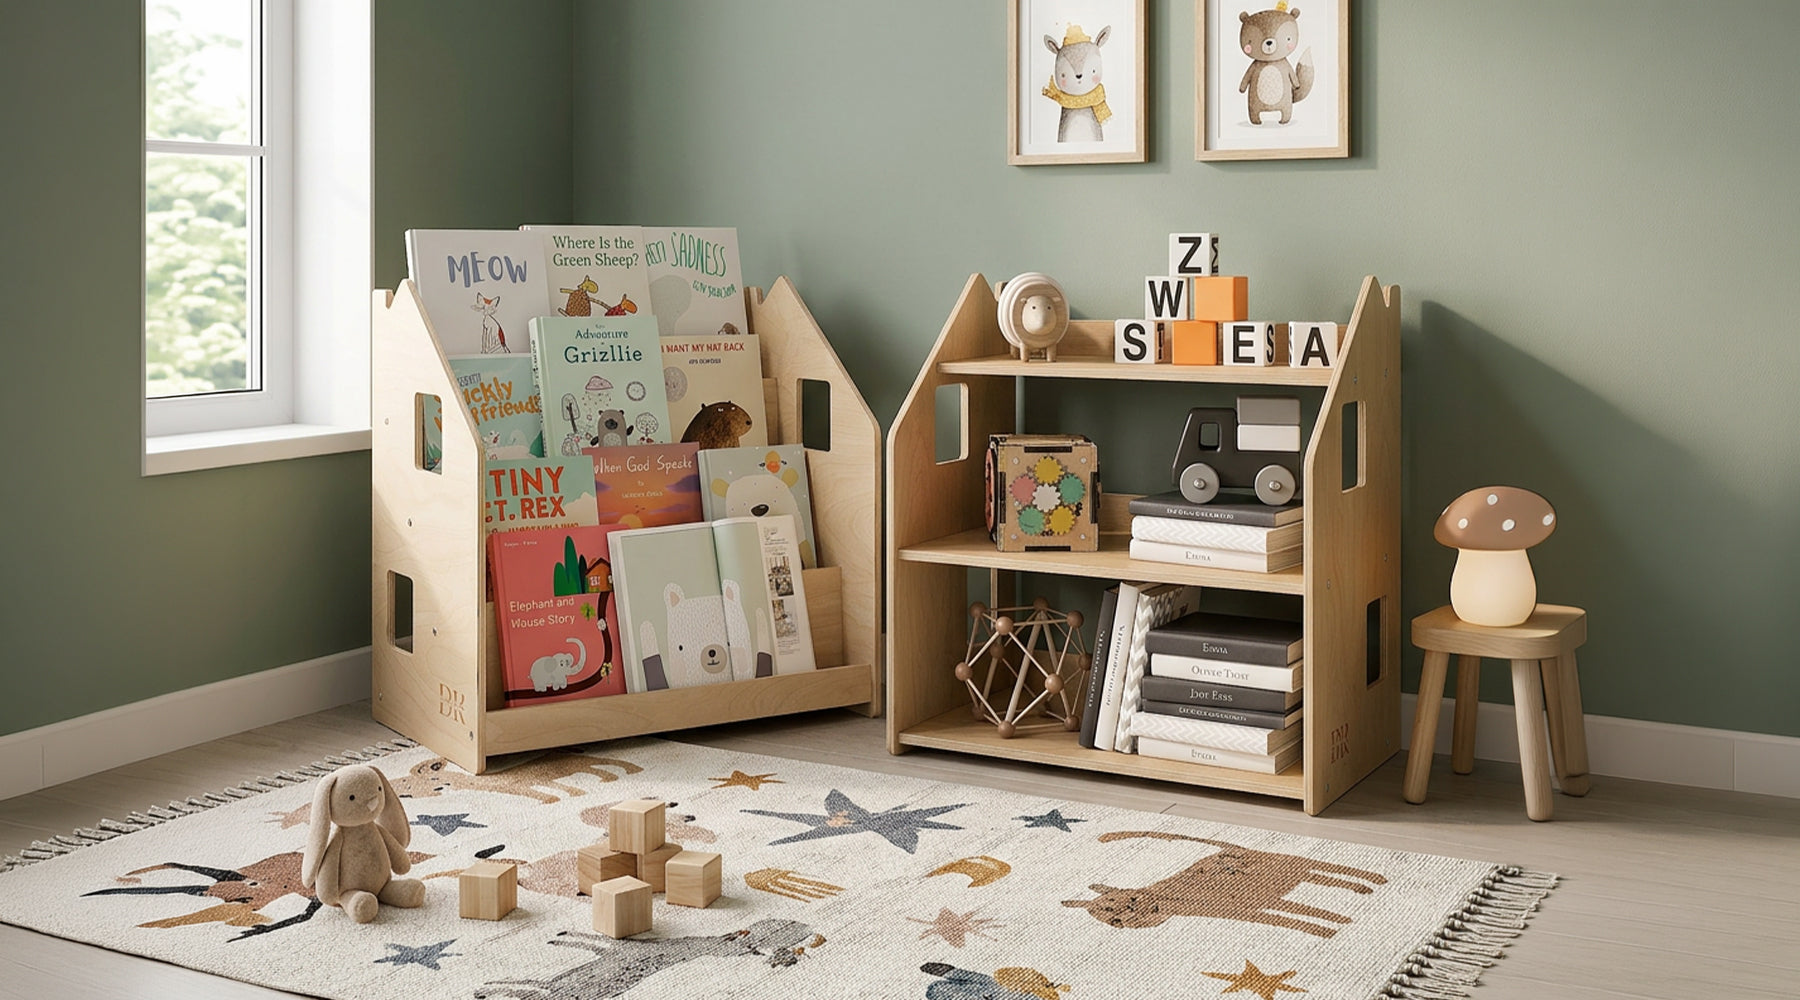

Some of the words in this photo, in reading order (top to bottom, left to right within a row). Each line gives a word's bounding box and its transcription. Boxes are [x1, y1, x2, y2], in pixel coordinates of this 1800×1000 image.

[553, 235, 595, 249] Where
[599, 236, 610, 249] Is
[614, 236, 634, 249] the
[670, 231, 726, 277] SADNESS
[1178, 236, 1202, 273] Z
[447, 251, 527, 288] MEOW
[553, 253, 591, 267] Green
[595, 252, 639, 269] Sheep?
[1148, 280, 1184, 318] W
[1123, 322, 1147, 361] S
[1232, 325, 1255, 363] E
[1300, 326, 1330, 367] A
[626, 455, 650, 472] God
[488, 466, 564, 497] TINY
[520, 495, 566, 520] REX
[509, 599, 554, 613] Elephant
[556, 597, 575, 608] and
[547, 613, 575, 625] Story
